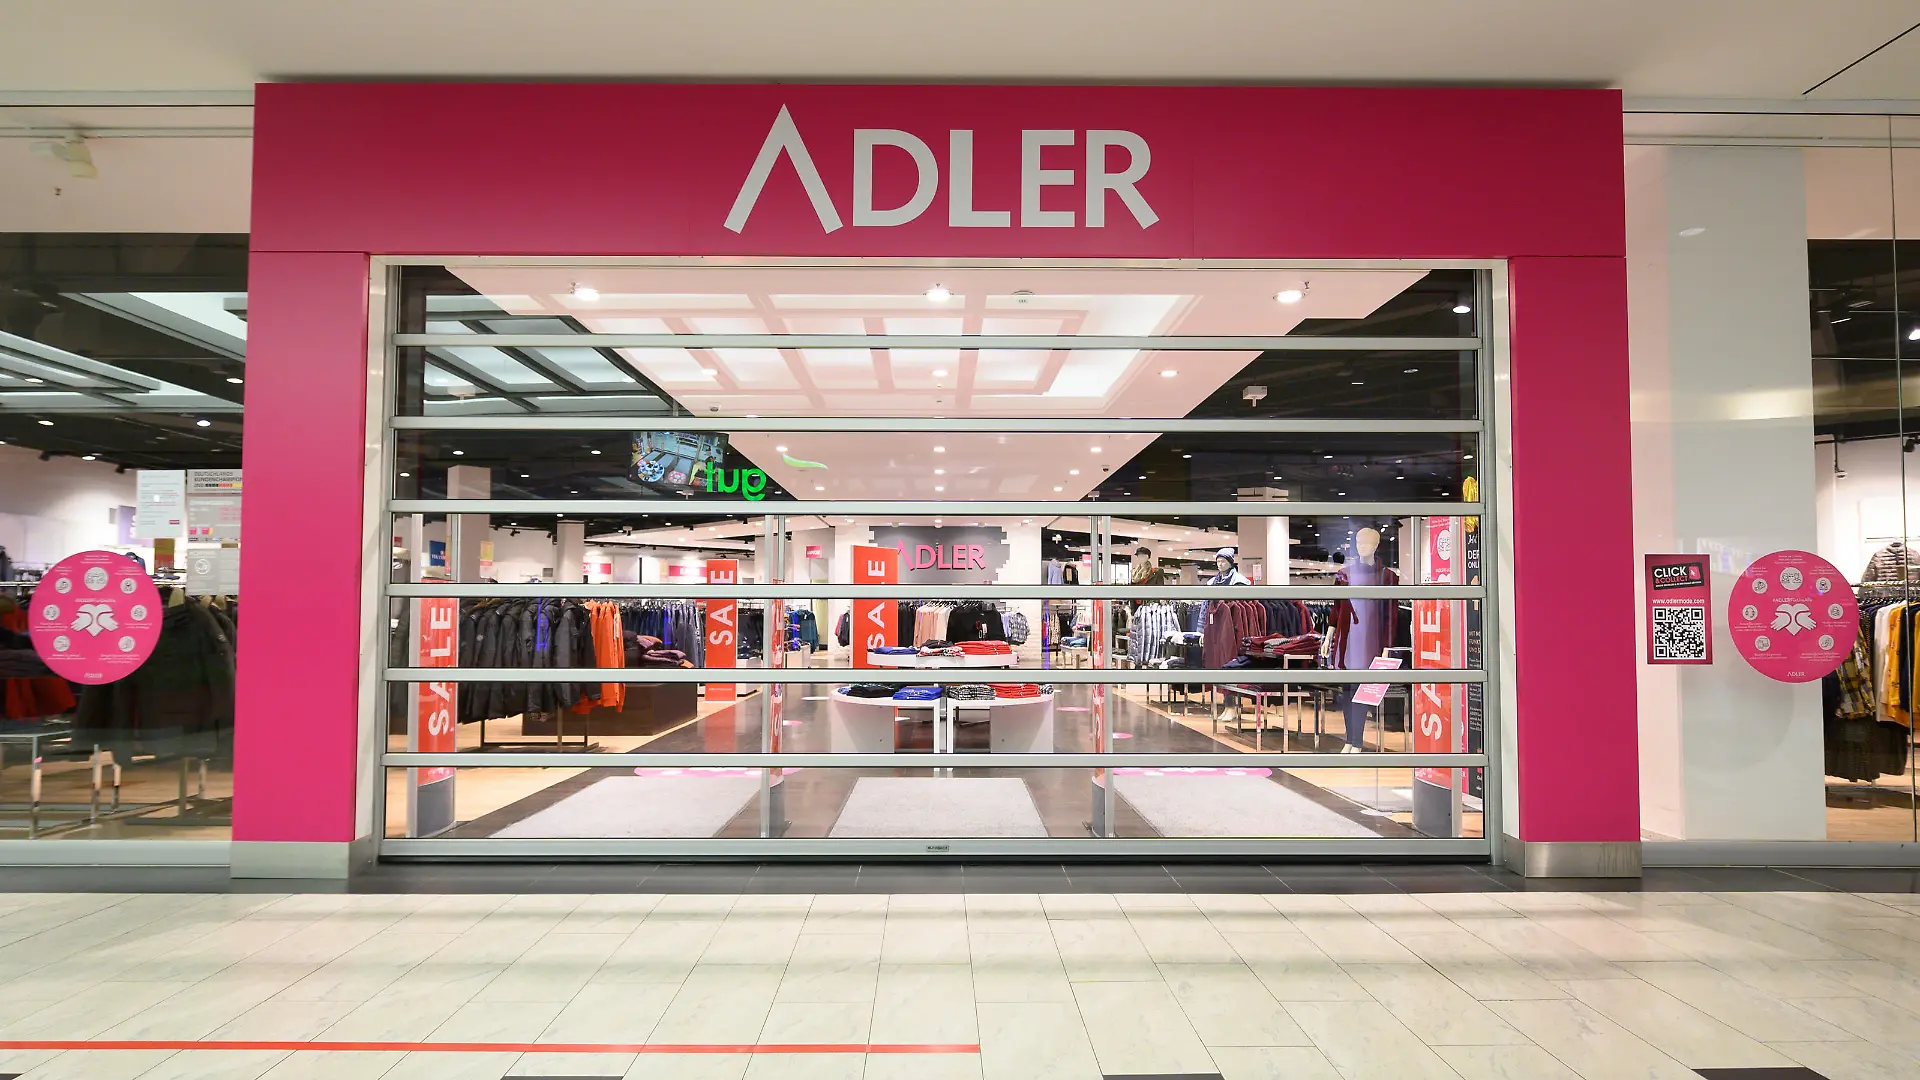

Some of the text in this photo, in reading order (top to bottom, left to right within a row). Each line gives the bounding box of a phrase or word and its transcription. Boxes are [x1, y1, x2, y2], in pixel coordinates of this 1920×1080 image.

[723, 103, 1160, 234] ADLER
[710, 570, 734, 646] SAE
[867, 560, 886, 650] SAE
[1654, 566, 1687, 578] CLICK
